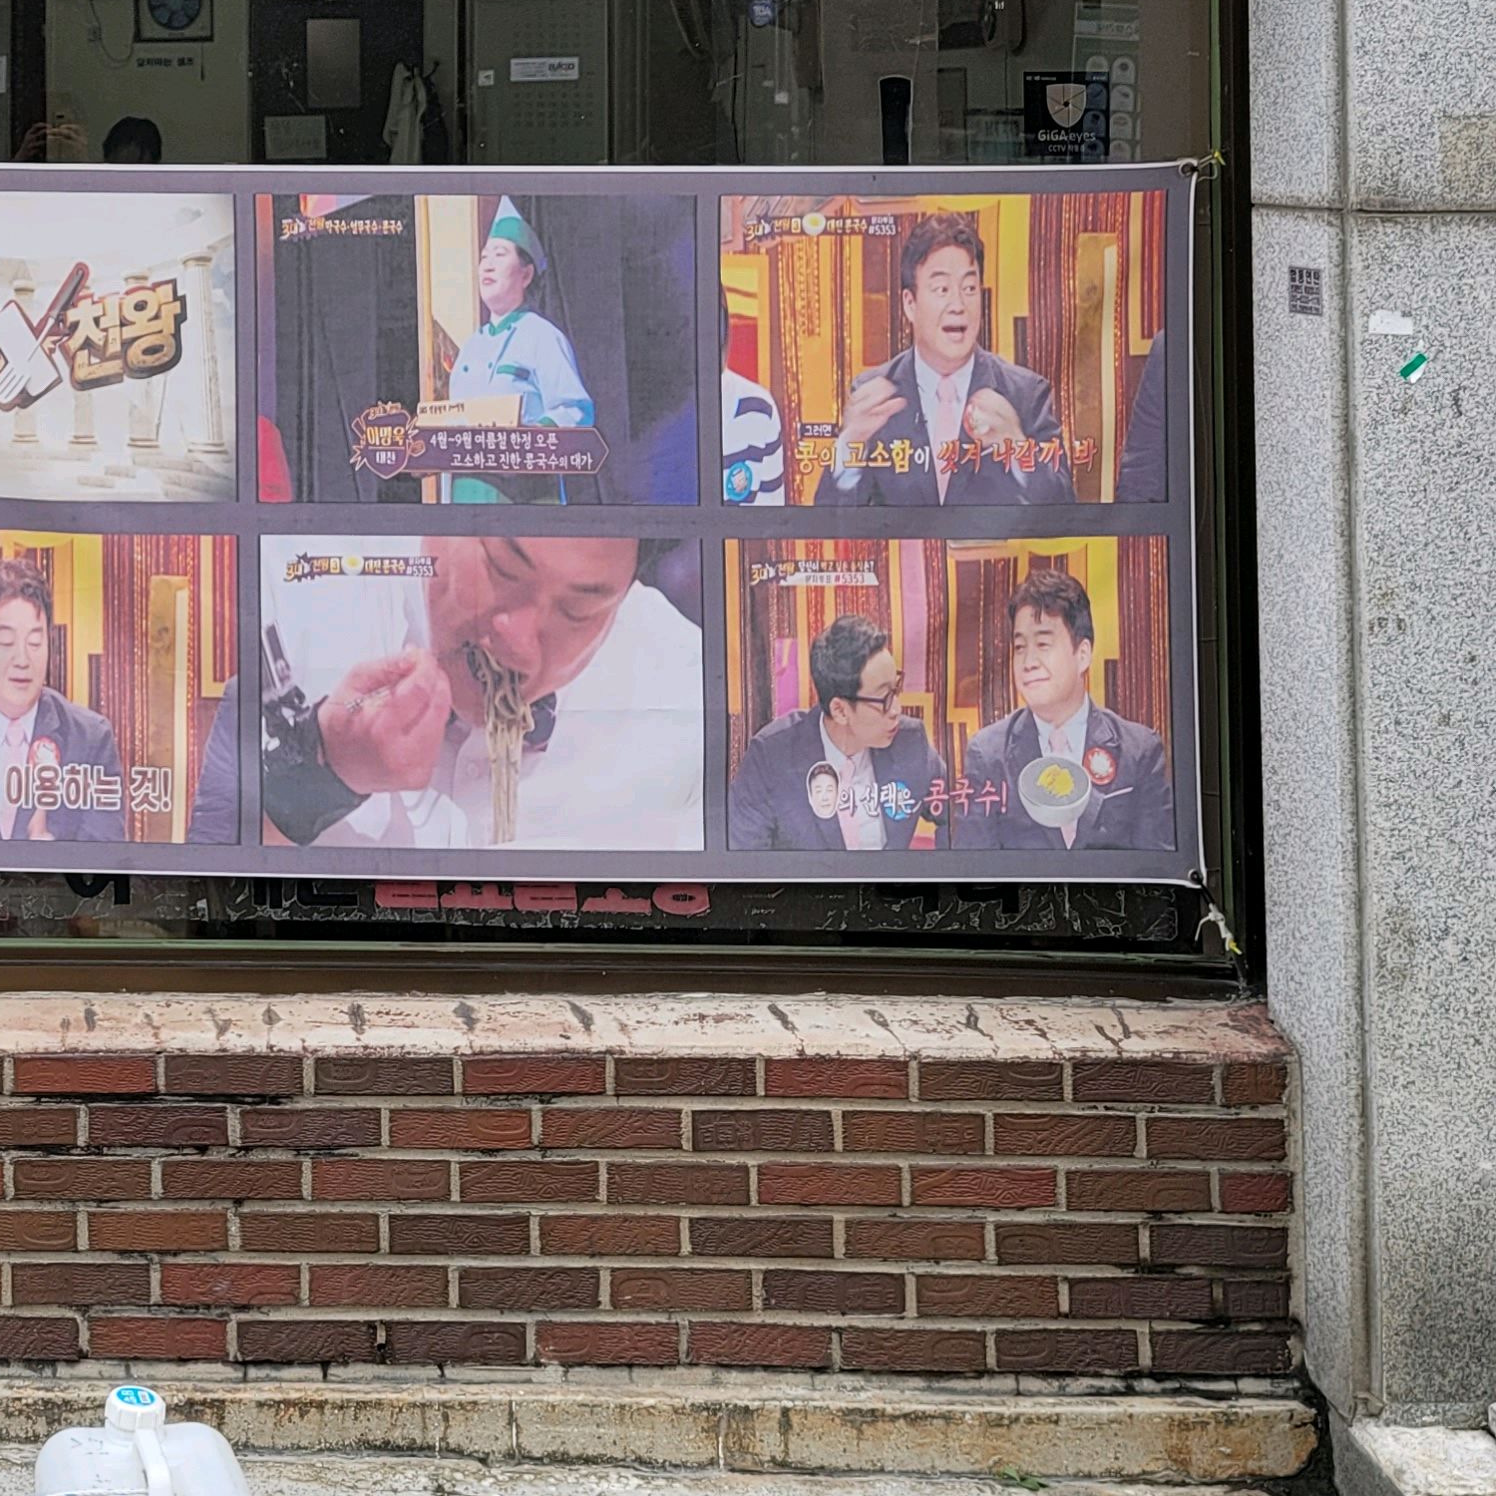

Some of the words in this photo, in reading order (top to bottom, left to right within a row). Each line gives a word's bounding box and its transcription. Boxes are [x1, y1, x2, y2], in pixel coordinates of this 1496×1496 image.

[450, 452, 498, 469] 고소하고
[499, 452, 522, 470] 진한
[794, 439, 836, 474] 콩의
[842, 438, 931, 474] 고소함이
[6, 762, 122, 811] 이용하는
[129, 765, 173, 813] 것!
[923, 779, 1009, 817] 콩국수!
